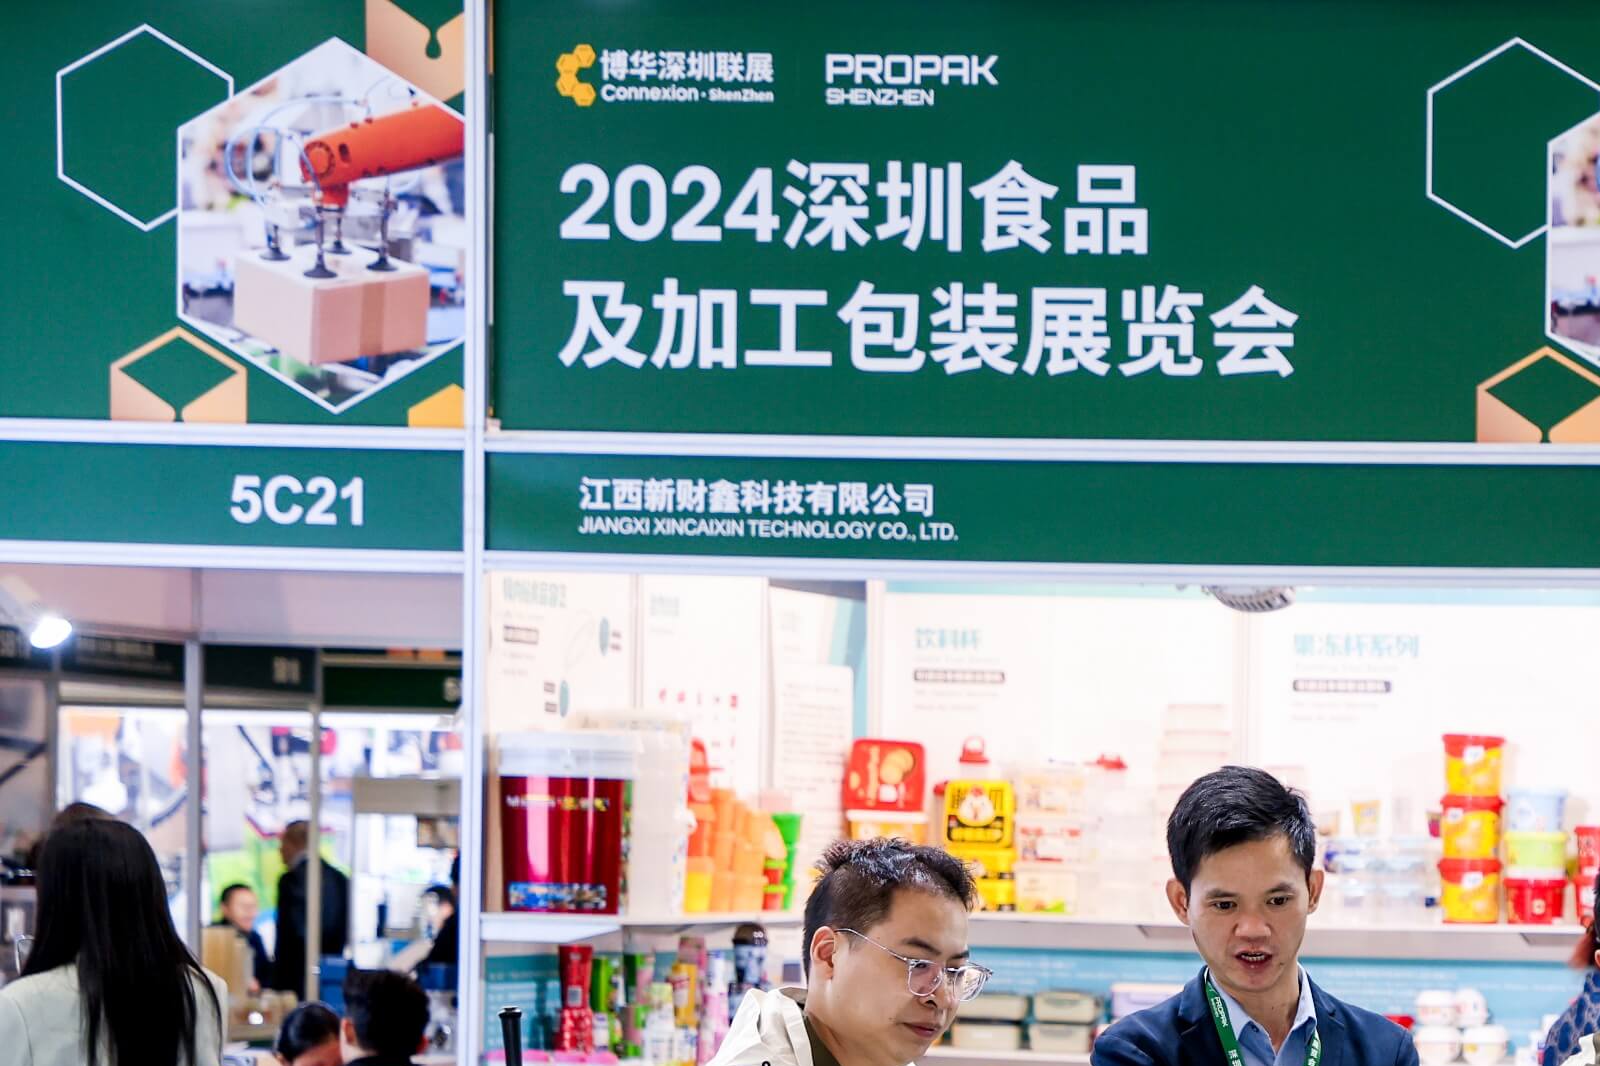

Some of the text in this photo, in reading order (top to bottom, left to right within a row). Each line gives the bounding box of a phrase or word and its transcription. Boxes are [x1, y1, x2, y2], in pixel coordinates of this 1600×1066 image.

[600, 49, 774, 82] 博华深圳联展
[826, 54, 999, 86] PROPAK
[601, 84, 774, 102] Connexion ShenZhen
[826, 87, 935, 106] SHENZHEN
[560, 158, 1149, 255] 2024深圳食品
[559, 278, 1300, 378] 及加工包装展览会
[230, 475, 364, 526] 5C21
[579, 476, 934, 517] 江西新财鑫科技有限公司
[578, 516, 958, 542] JIANGXI XINCAIXIN TECHNOLOGY CO., LTD.
